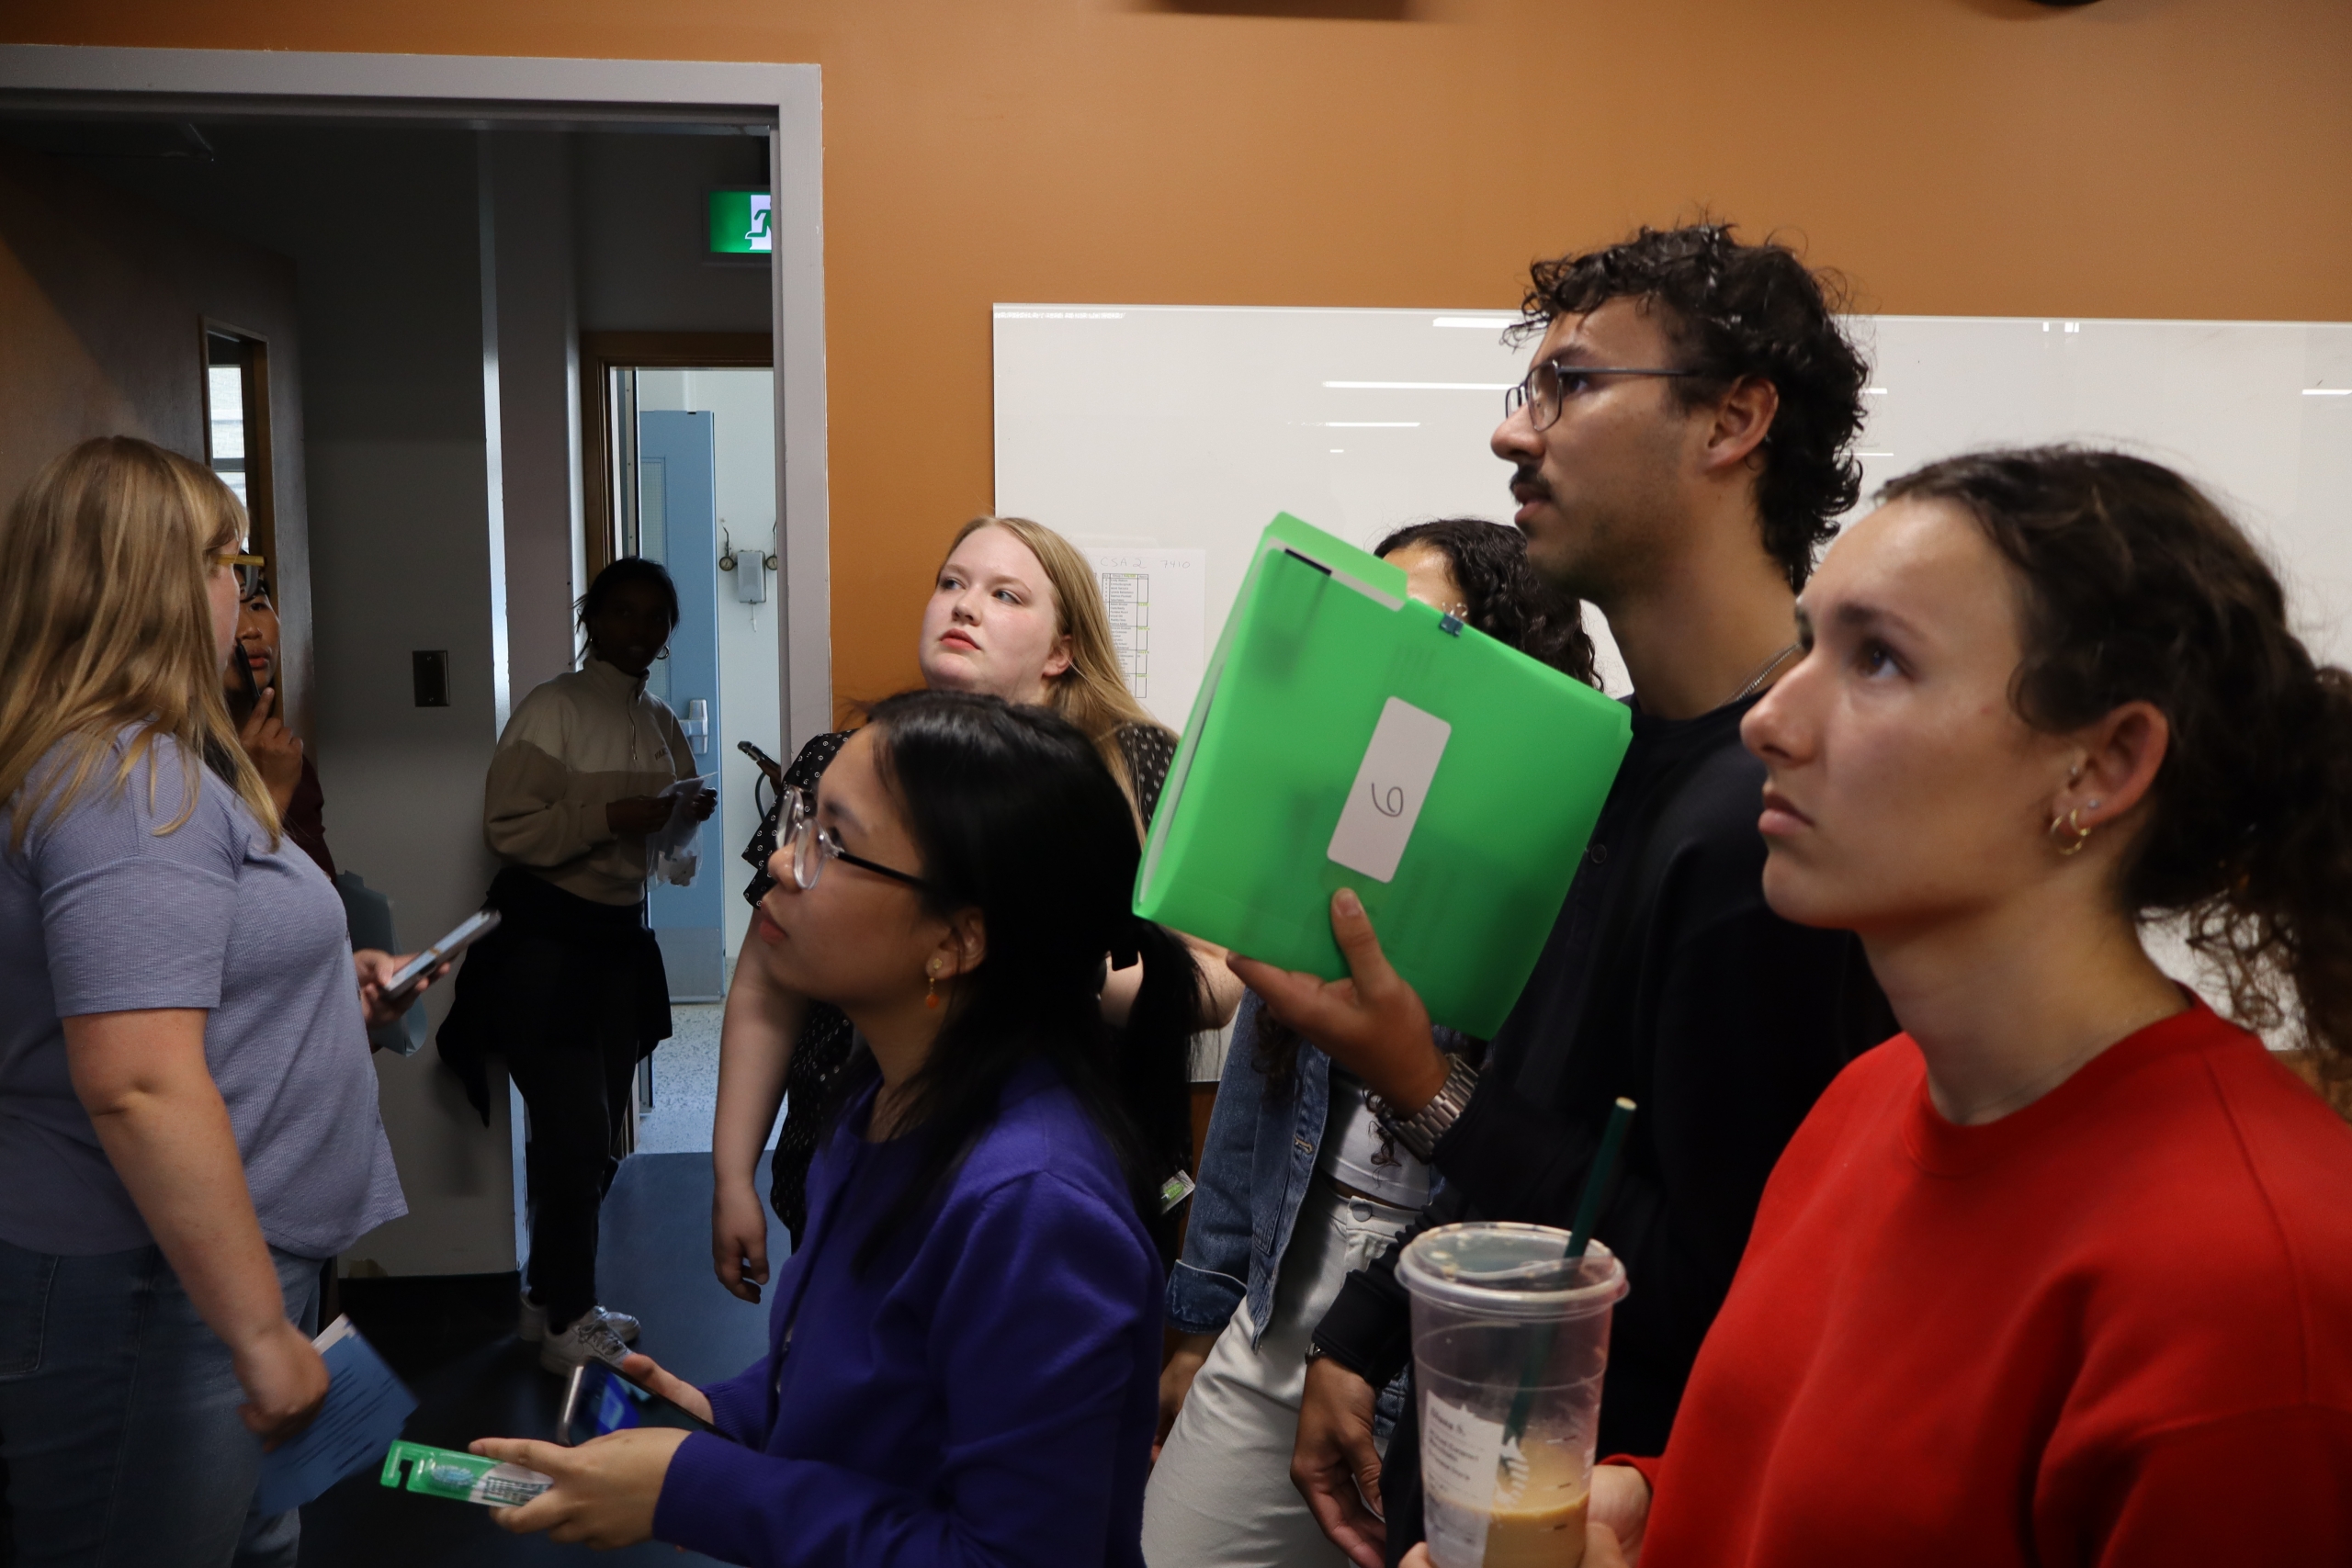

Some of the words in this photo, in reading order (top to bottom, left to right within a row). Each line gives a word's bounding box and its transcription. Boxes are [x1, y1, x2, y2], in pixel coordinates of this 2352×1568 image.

[1100, 557, 1127, 568] CSA
[1132, 558, 1148, 570] 2
[1159, 559, 1191, 570] 7410
[1371, 782, 1404, 818] 6
